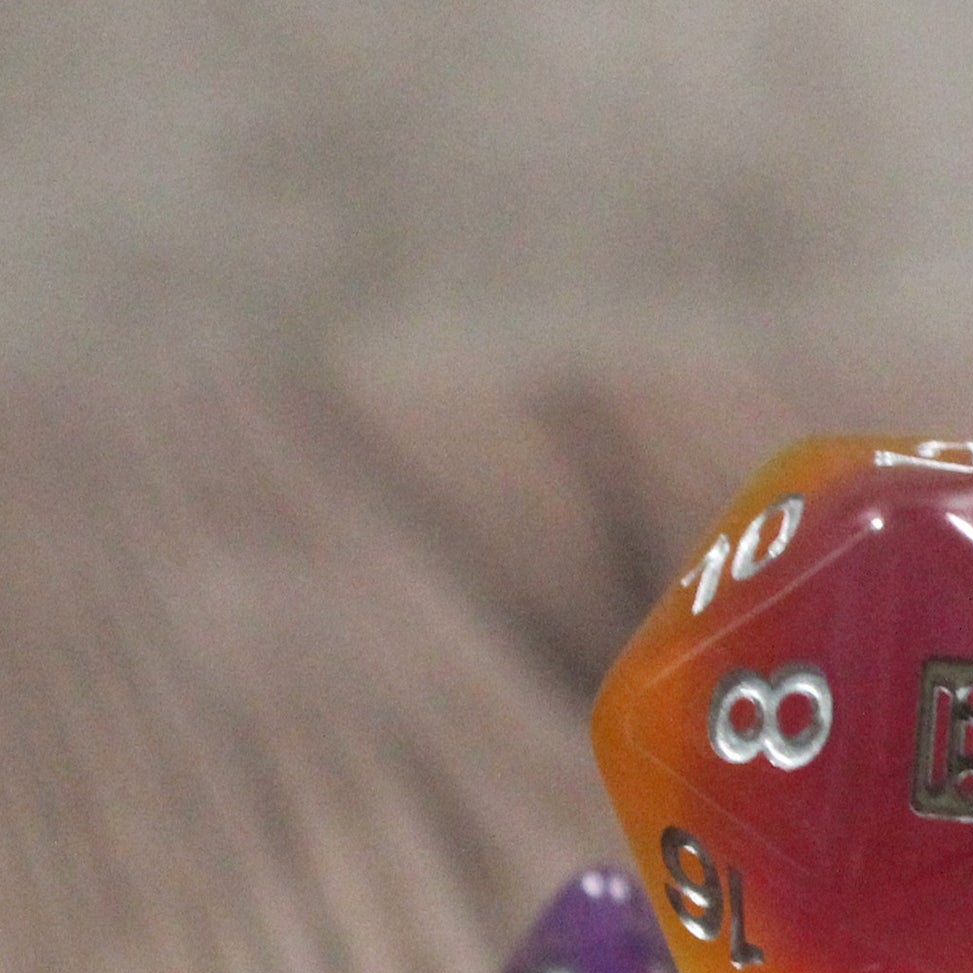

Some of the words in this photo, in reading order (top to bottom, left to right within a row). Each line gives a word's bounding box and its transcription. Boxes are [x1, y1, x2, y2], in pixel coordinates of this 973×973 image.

[681, 494, 804, 614] 10
[706, 661, 833, 772] 8
[661, 826, 764, 970] 16
